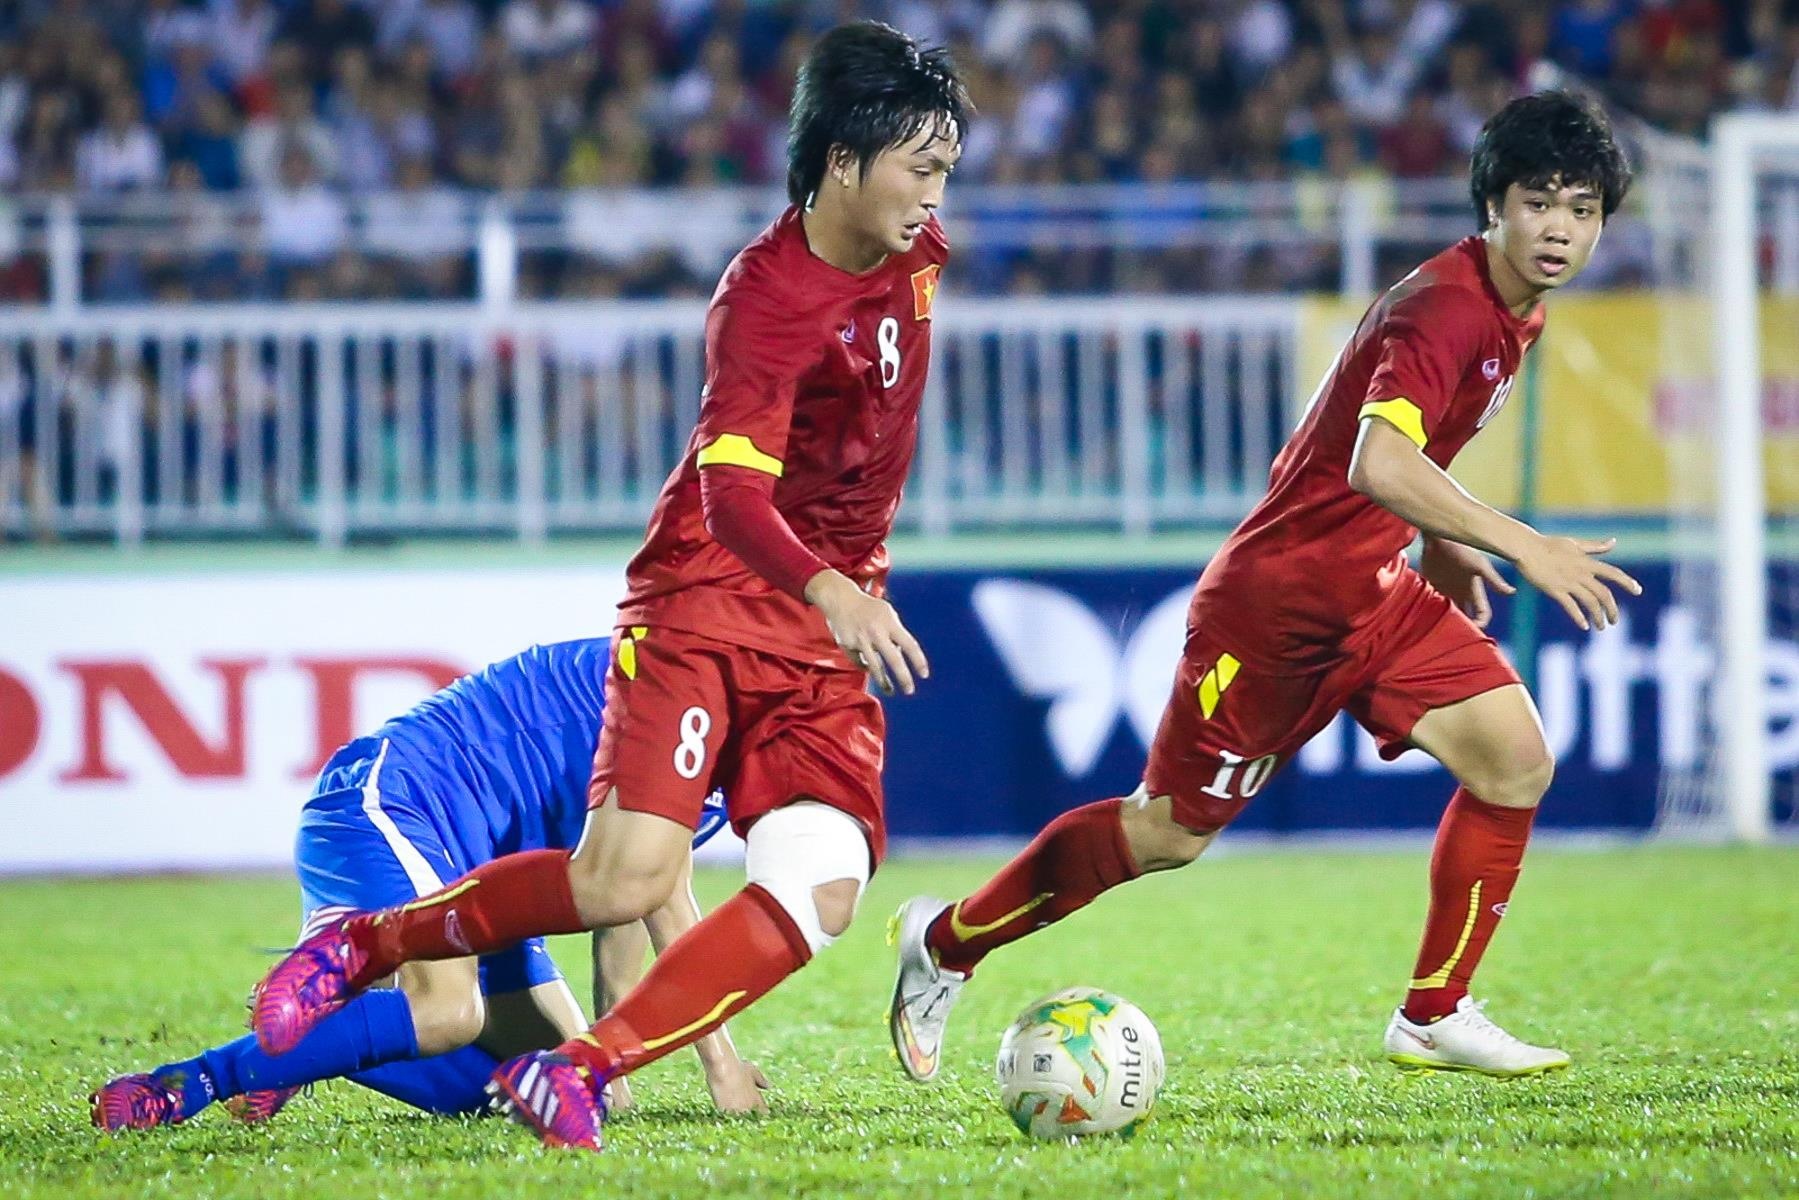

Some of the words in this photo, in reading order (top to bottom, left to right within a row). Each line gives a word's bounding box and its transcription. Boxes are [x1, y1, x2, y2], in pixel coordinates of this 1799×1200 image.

[877, 316, 901, 390] 8
[673, 705, 711, 780] 8
[1200, 749, 1277, 800] 10
[1119, 1025, 1143, 1109] mitre
